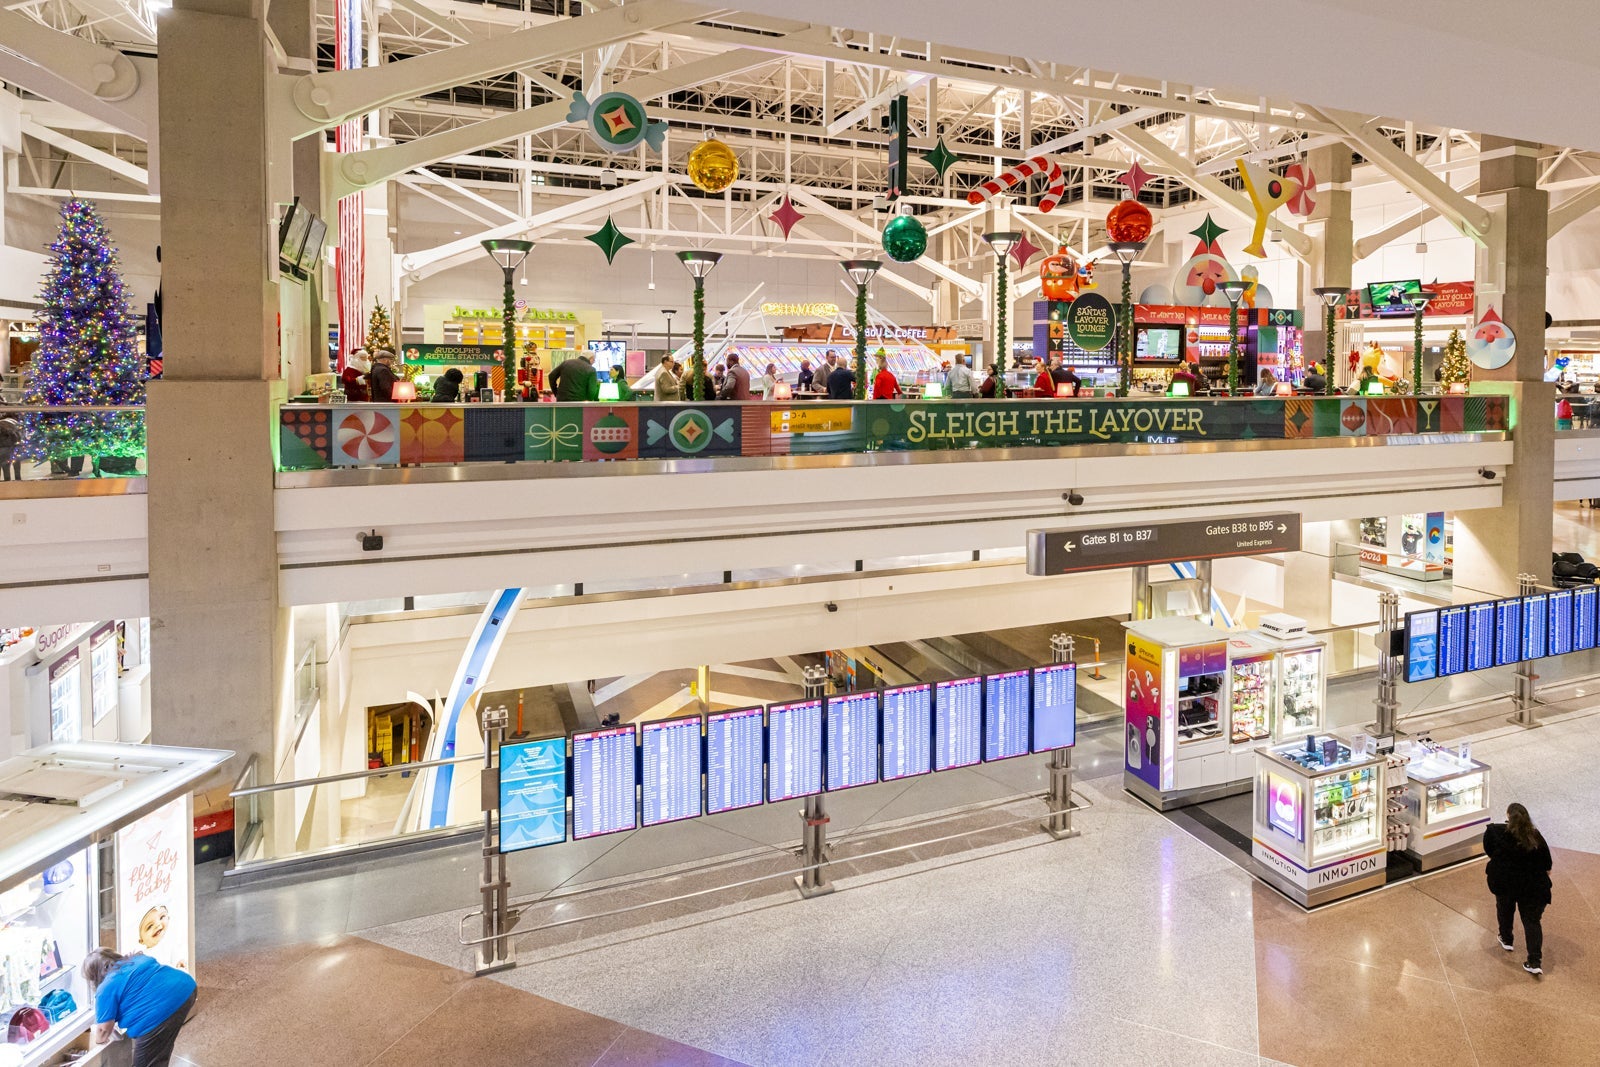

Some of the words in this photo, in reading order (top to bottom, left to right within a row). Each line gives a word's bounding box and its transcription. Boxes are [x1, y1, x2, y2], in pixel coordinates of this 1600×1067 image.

[1077, 305, 1107, 316] SANTA'S
[1435, 301, 1465, 309] LAYOVER
[453, 306, 503, 318] Jamb
[529, 308, 577, 320] Juice
[1223, 313, 1248, 321] COIES
[1074, 316, 1109, 326] LAYOVER
[842, 327, 883, 337] CBOU
[895, 328, 927, 338] COFFEE
[1077, 324, 1106, 333] LOUNGE
[907, 410, 1019, 442] SLEIGH
[1026, 409, 1083, 435] THE
[1089, 408, 1207, 439] LAYOVER
[1205, 525, 1230, 535] Gates
[1231, 522, 1247, 533] B38
[1249, 523, 1258, 532] to
[1259, 520, 1274, 531] B95
[1082, 534, 1107, 545] Gates
[1109, 532, 1120, 543] B1
[1123, 532, 1133, 542] to
[1136, 529, 1152, 541] B37
[1236, 540, 1253, 548] United
[1253, 539, 1273, 547] Express
[1260, 623, 1283, 632] BOSE
[1285, 626, 1306, 634] BOSE
[128, 863, 153, 888] fly
[154, 847, 178, 871] fly
[1261, 850, 1297, 877] INMOTION
[1318, 857, 1377, 884] INMOTION
[133, 870, 173, 903] baby
